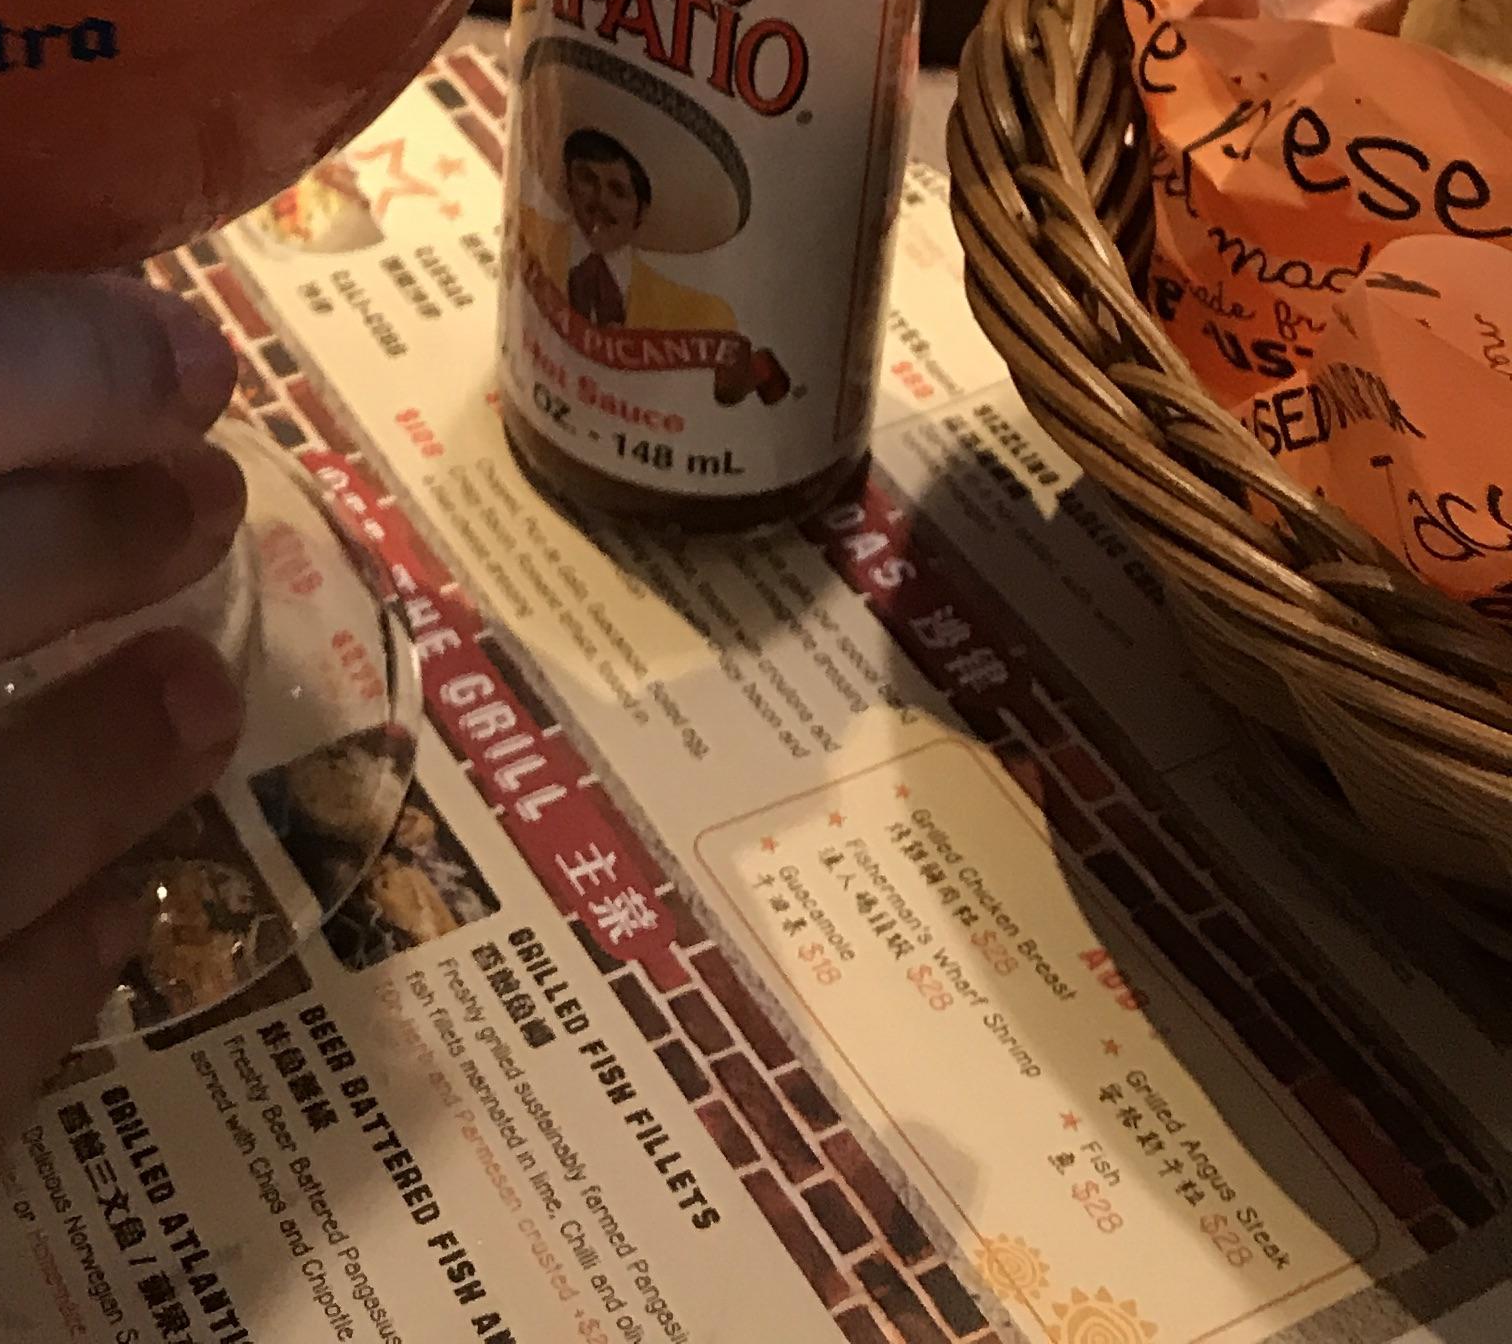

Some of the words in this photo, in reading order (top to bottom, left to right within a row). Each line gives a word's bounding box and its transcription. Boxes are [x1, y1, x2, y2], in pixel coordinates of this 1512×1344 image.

[586, 330, 741, 370] PICANTE
[612, 430, 675, 473] 148
[687, 448, 746, 477] mL
[441, 676, 568, 823] GRILL
[554, 840, 659, 946] 主菜
[910, 805, 964, 866] Grilled
[956, 865, 1022, 938] Chicken
[1015, 937, 1078, 1003] Breast
[775, 863, 860, 961] Guacamole
[795, 937, 845, 989] $18
[843, 836, 936, 944] Fisherman's
[931, 947, 988, 1010] Wharf
[981, 1009, 1046, 1082] Shrimp
[904, 959, 956, 1014] $28
[969, 924, 1020, 978] $28
[298, 1002, 356, 1074] BEER
[339, 1076, 442, 1224] BATTERED
[426, 1229, 487, 1306] FISH
[402, 967, 438, 1008] fish
[458, 1058, 526, 1149] marinated
[514, 1147, 539, 1171] in
[556, 1218, 601, 1271] Chilli
[588, 1270, 627, 1314] and
[433, 957, 488, 1025] Freshly
[476, 1023, 525, 1082] grilled
[511, 1080, 589, 1183] sustainably
[578, 1184, 636, 1258] farmed
[507, 925, 592, 1034] GRILLED
[579, 1036, 637, 1106] FISH
[624, 1109, 721, 1231] FILLETS
[1079, 1137, 1124, 1188] Fish
[1123, 1067, 1185, 1134] Grilled
[1178, 1136, 1238, 1205] Angus
[1234, 1204, 1292, 1270] Steak
[10, 1197, 38, 1226] or
[17, 1124, 75, 1214] Delicious
[54, 1215, 131, 1325] Norwegian
[98, 1084, 179, 1204] GRILLED
[158, 1209, 251, 1344] ATLANTI
[188, 1048, 235, 1112] served
[223, 1112, 259, 1155] with
[243, 1156, 291, 1216] Chips
[276, 1215, 314, 1258] and
[296, 1258, 360, 1343] Chipotle
[220, 1034, 274, 1106] Freshly
[260, 1105, 301, 1156] Beer
[286, 1157, 349, 1244] Battered
[332, 1247, 407, 1344] Pangasius
[515, 1215, 581, 1301] crusted
[1067, 1175, 1125, 1237] $28
[1195, 1208, 1254, 1272] $28
